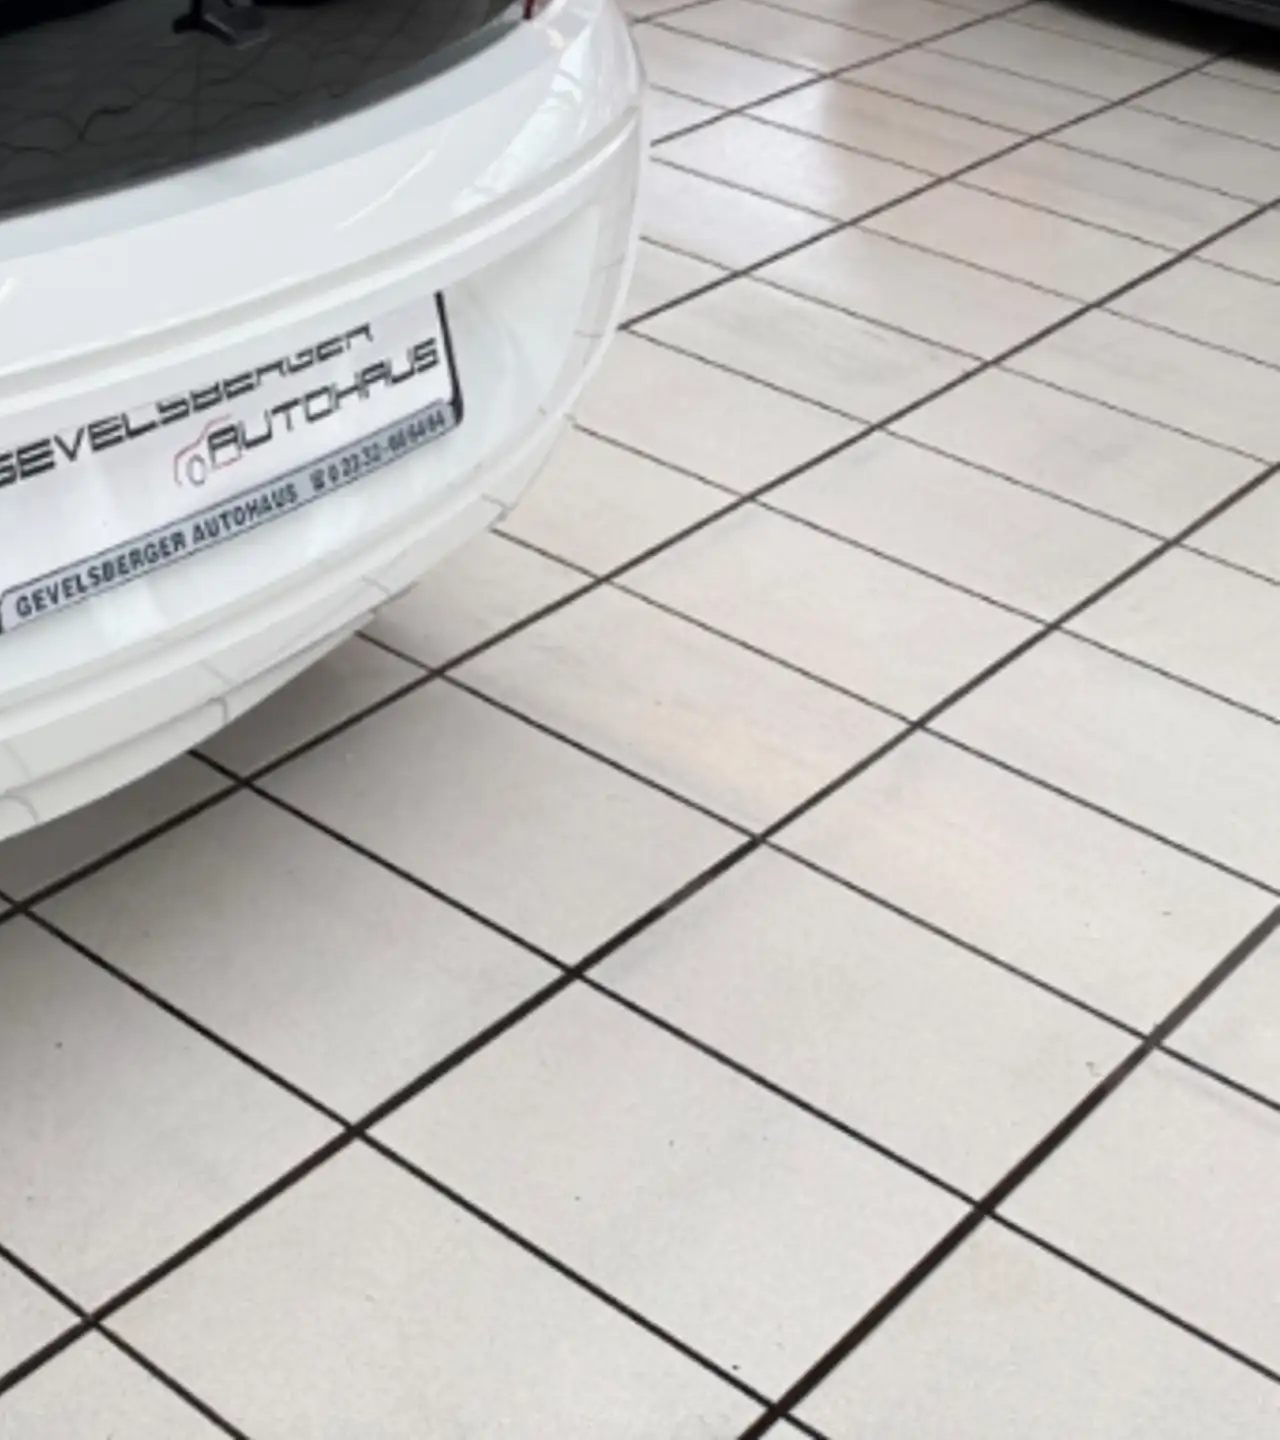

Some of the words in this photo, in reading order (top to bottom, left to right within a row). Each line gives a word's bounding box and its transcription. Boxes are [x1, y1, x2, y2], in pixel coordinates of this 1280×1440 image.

[206, 337, 441, 470] AUTOHAUS
[15, 528, 187, 619] GEVELSBERGER
[192, 483, 299, 546] AUTOHAUS
